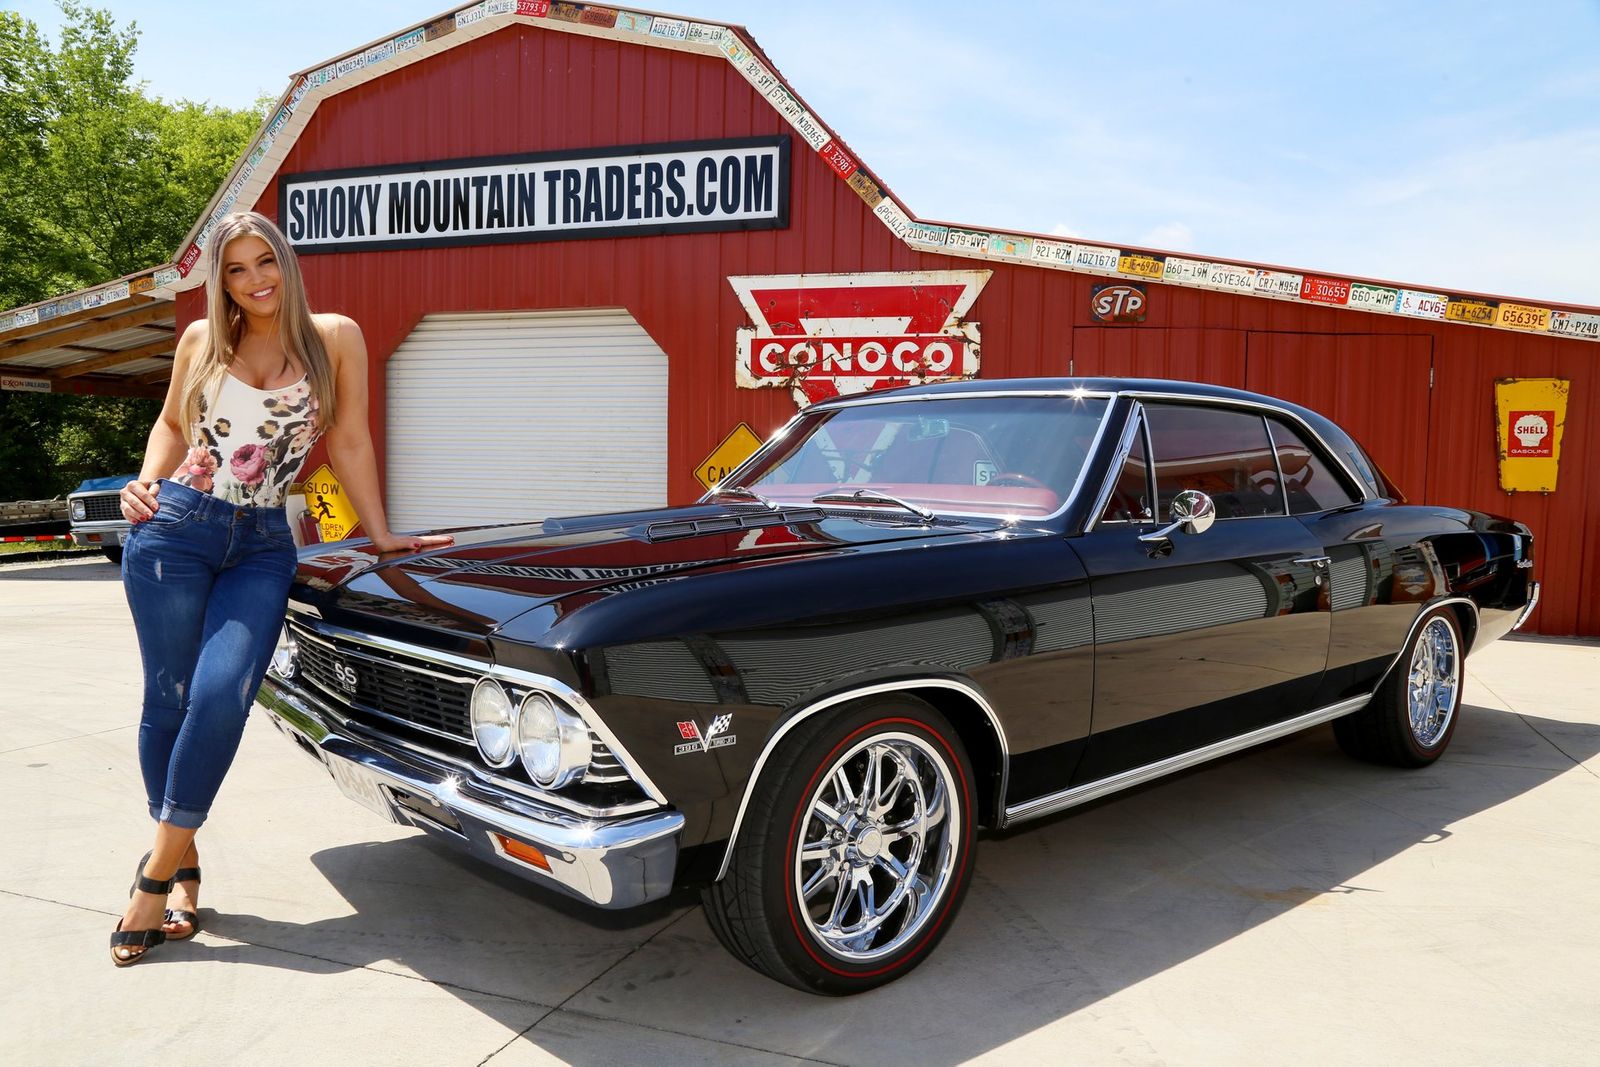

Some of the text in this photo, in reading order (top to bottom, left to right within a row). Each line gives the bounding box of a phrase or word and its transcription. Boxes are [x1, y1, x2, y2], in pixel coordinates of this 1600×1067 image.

[796, 116, 825, 146] N303652
[289, 154, 774, 241] SMOKY MOUNTAIN TRADERS.COM
[876, 204, 907, 235] 6PGJ412
[1035, 245, 1072, 261] 921-RZM
[1076, 252, 1117, 268] ADZ1678
[1165, 262, 1208, 279] B60-19M
[1211, 272, 1251, 287] 6SYE364
[1096, 289, 1142, 316] STP
[1417, 299, 1441, 313] ACV6
[1502, 309, 1545, 326] G5639E
[759, 341, 954, 372] CONOCO
[2, 379, 24, 388] EXXON
[1517, 425, 1545, 435] SHELL
[306, 481, 340, 495] SLOW
[325, 531, 343, 539] PLAY
[335, 662, 357, 685] SS
